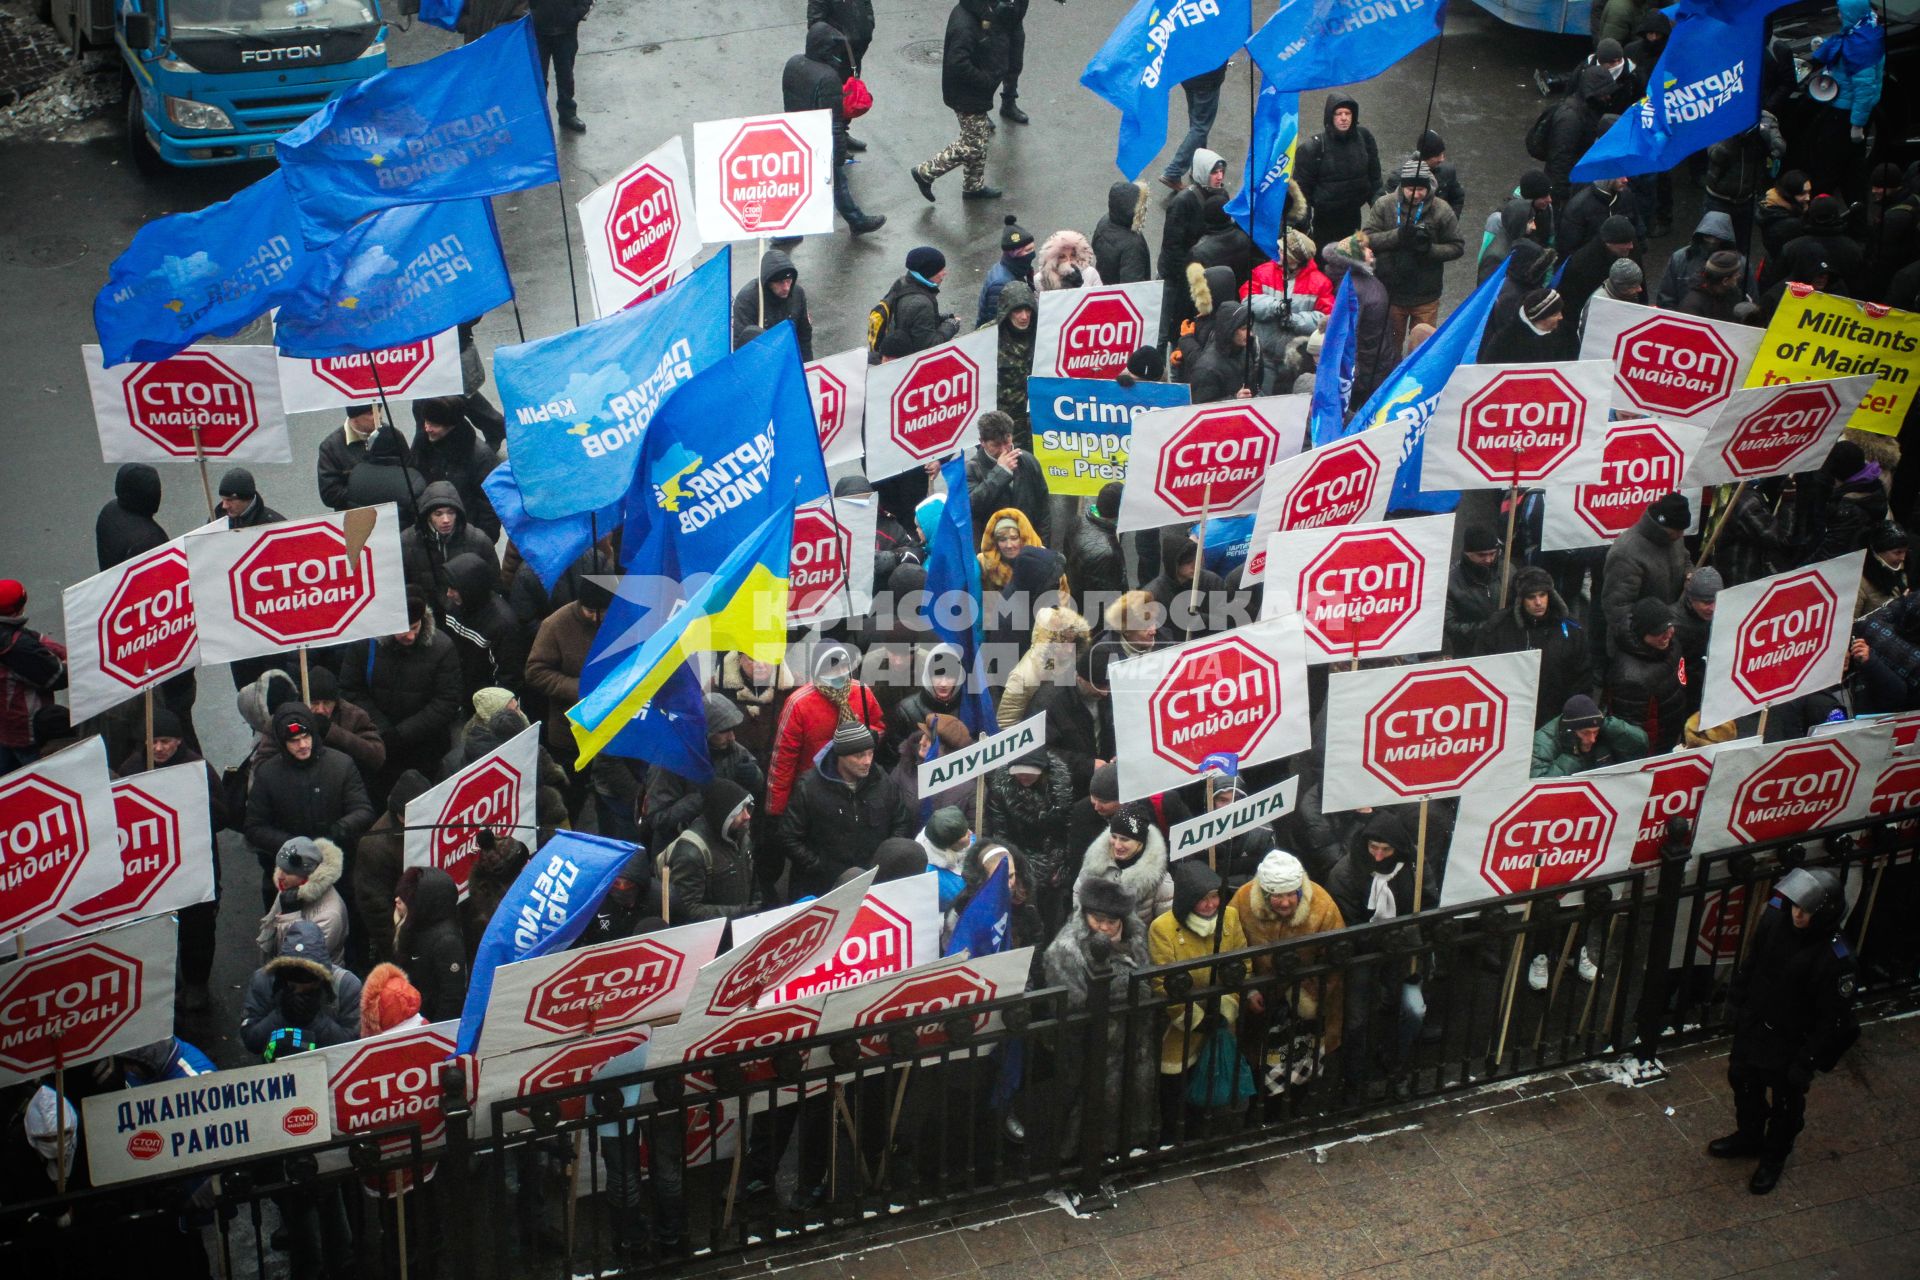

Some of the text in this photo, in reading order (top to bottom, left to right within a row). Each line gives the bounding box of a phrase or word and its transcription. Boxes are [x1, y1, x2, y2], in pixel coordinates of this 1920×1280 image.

[241, 45, 321, 63] FOTON
[731, 150, 800, 180] СТОП
[734, 182, 800, 202] майдан
[615, 187, 669, 241] СТОП
[622, 217, 672, 264] майдан
[1070, 321, 1135, 349] СТОП
[1798, 309, 1918, 353] Militants
[1067, 346, 1129, 371] майдан
[1631, 339, 1721, 376] СТОП
[1776, 341, 1909, 384] of Maidan
[142, 382, 238, 406] СТОП
[903, 372, 968, 413] СТОП
[1627, 365, 1715, 394] майдан
[149, 408, 240, 427] майдан
[904, 400, 967, 435] майдан
[1053, 395, 1160, 424] Crim
[1477, 402, 1570, 428] СТОП
[1750, 407, 1826, 434] СТОП
[1042, 430, 1131, 459] suppo
[1174, 437, 1263, 468] СТОП
[1476, 429, 1565, 450] майдан
[1738, 431, 1810, 452] майдан
[1049, 465, 1069, 477] the
[1172, 465, 1258, 489] майдан
[1296, 468, 1368, 514] СТОП
[791, 537, 837, 562] ОП
[250, 555, 354, 591] СТОП
[1315, 562, 1408, 596] СТОП
[113, 580, 192, 636] СТОП
[255, 584, 355, 616] майдан
[1314, 593, 1404, 621] майдан
[116, 611, 195, 662] майдан
[1749, 603, 1825, 648] СТОП
[1747, 637, 1818, 674] майдан
[1167, 668, 1263, 720] СТОП
[1171, 703, 1264, 747] майдан
[1384, 701, 1489, 739] СТОП
[928, 727, 1034, 788] АЛУШТА
[1384, 736, 1486, 763] майдан
[1752, 769, 1844, 803] СТОП
[442, 783, 510, 845] СТОП
[1177, 792, 1284, 852] АЛУШТА
[1745, 798, 1833, 825] майдан
[1504, 816, 1600, 847] СТОП
[735, 919, 821, 984] СТОП
[551, 960, 665, 1000] СТОП
[1, 971, 120, 1026] СТОП
[547, 982, 656, 1016] майдан
[1, 1001, 119, 1050] майдан
[704, 1023, 811, 1057] СТОП
[117, 1072, 297, 1133] ДЖАНКОЙСКИЙ
[287, 1114, 314, 1123] СТОП
[349, 1094, 440, 1130] майда
[171, 1119, 250, 1157] РАЙОН
